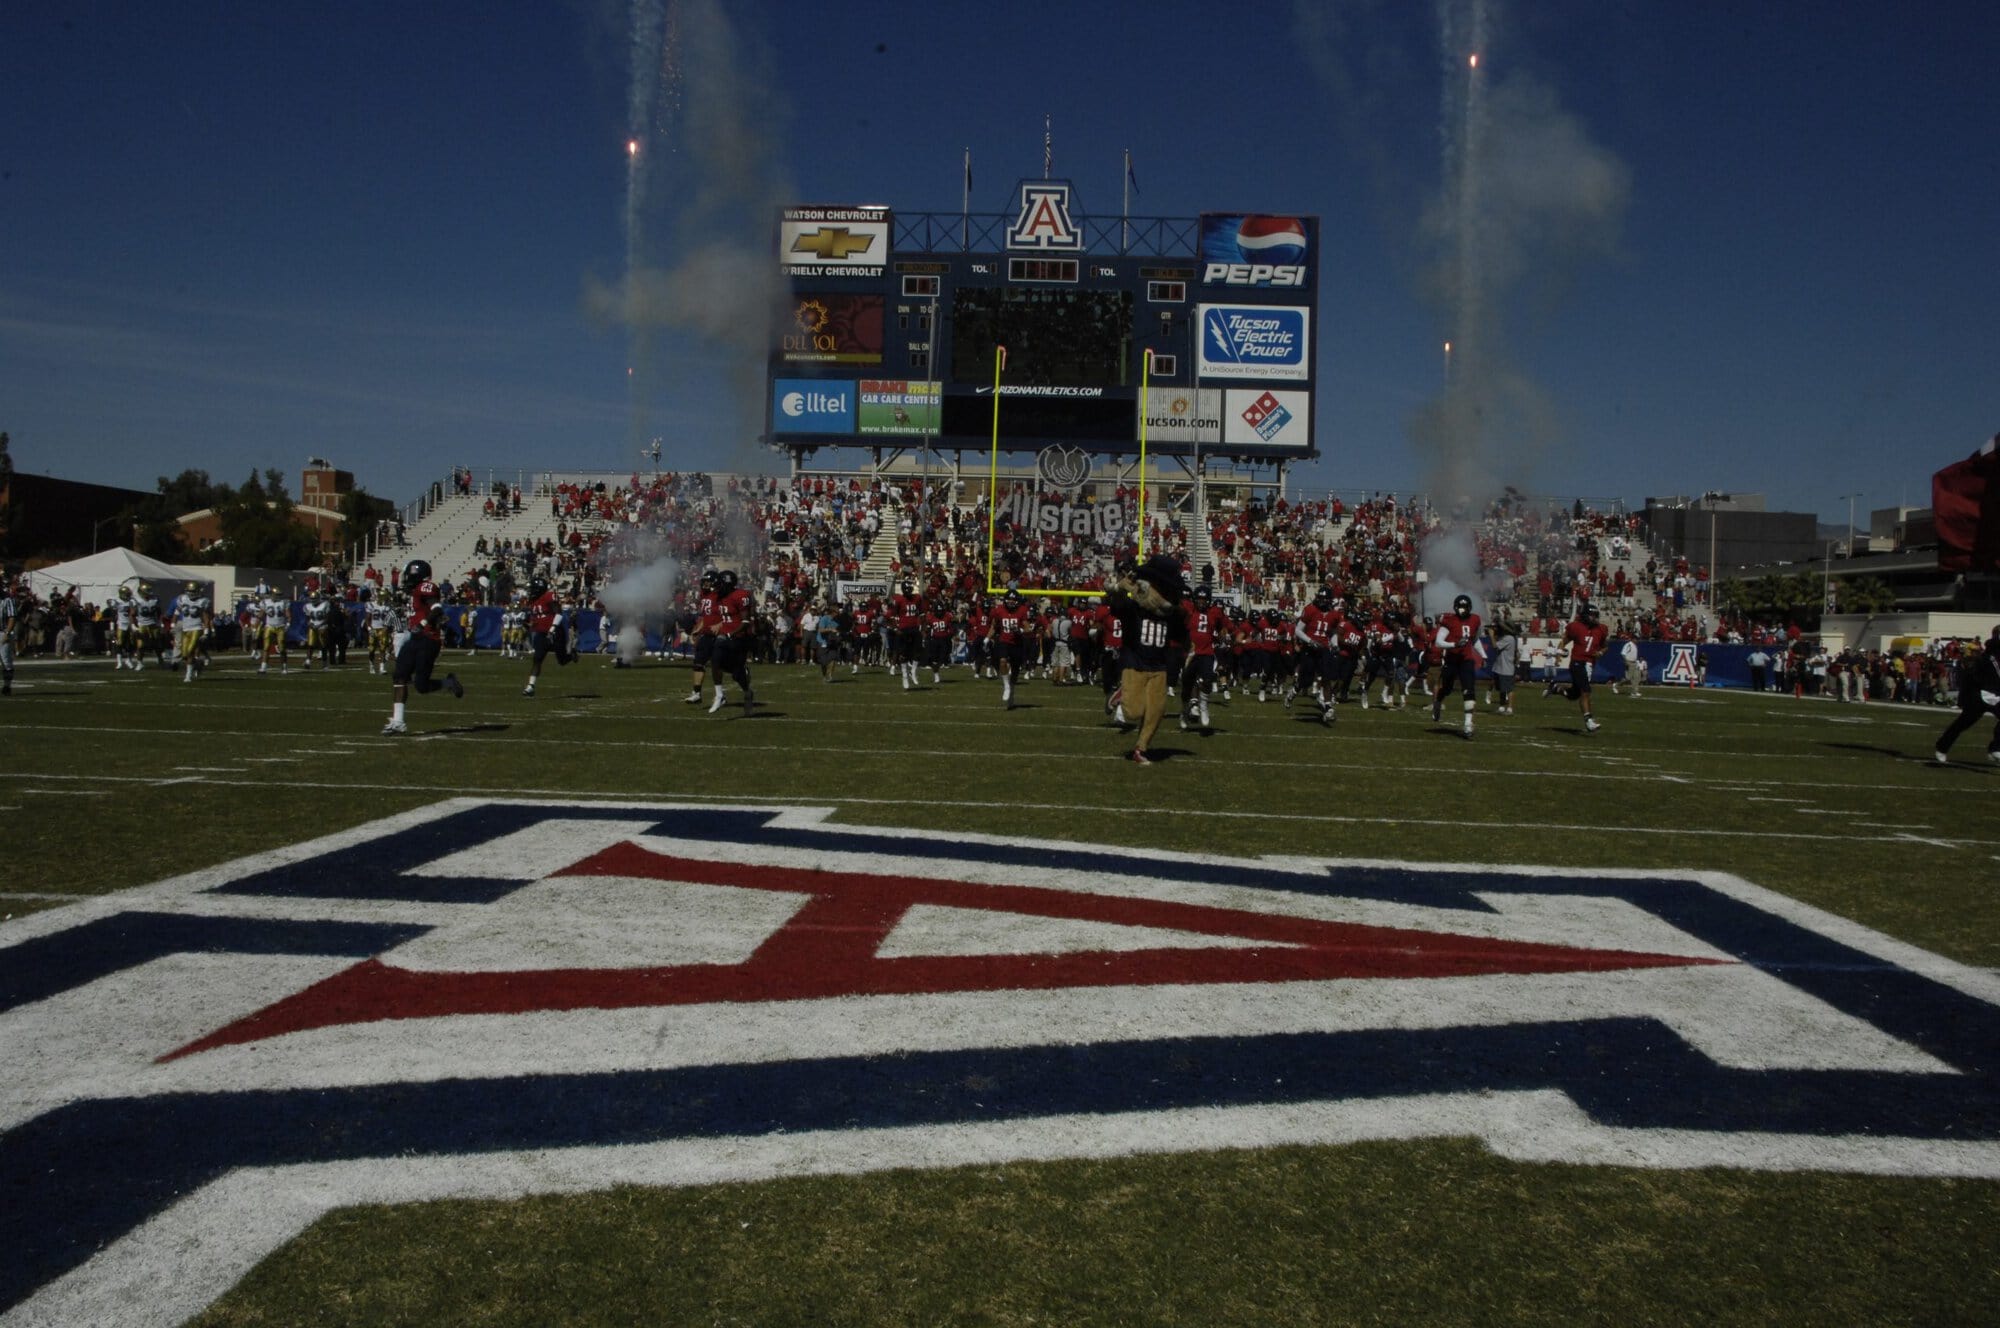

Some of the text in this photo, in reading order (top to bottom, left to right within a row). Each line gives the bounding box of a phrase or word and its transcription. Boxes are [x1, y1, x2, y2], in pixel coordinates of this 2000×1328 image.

[784, 210, 885, 221] WATSON CHEVROLET
[1007, 185, 1081, 249] A
[782, 266, 883, 277] O'RIELLY CHEVROLET
[971, 264, 988, 273] TOL
[1099, 268, 1116, 277] TOL
[1203, 263, 1306, 286] PEPSI
[1229, 315, 1280, 330] Tucson
[813, 334, 837, 351] SOL
[1233, 329, 1293, 344] Electric
[1240, 342, 1293, 357] Power
[861, 394, 878, 403] CAR
[880, 394, 902, 404] CARE
[995, 493, 1123, 535] Allstate
[1198, 613, 1208, 633] 2
[1583, 636, 1593, 652] 7
[1663, 644, 1698, 683] A
